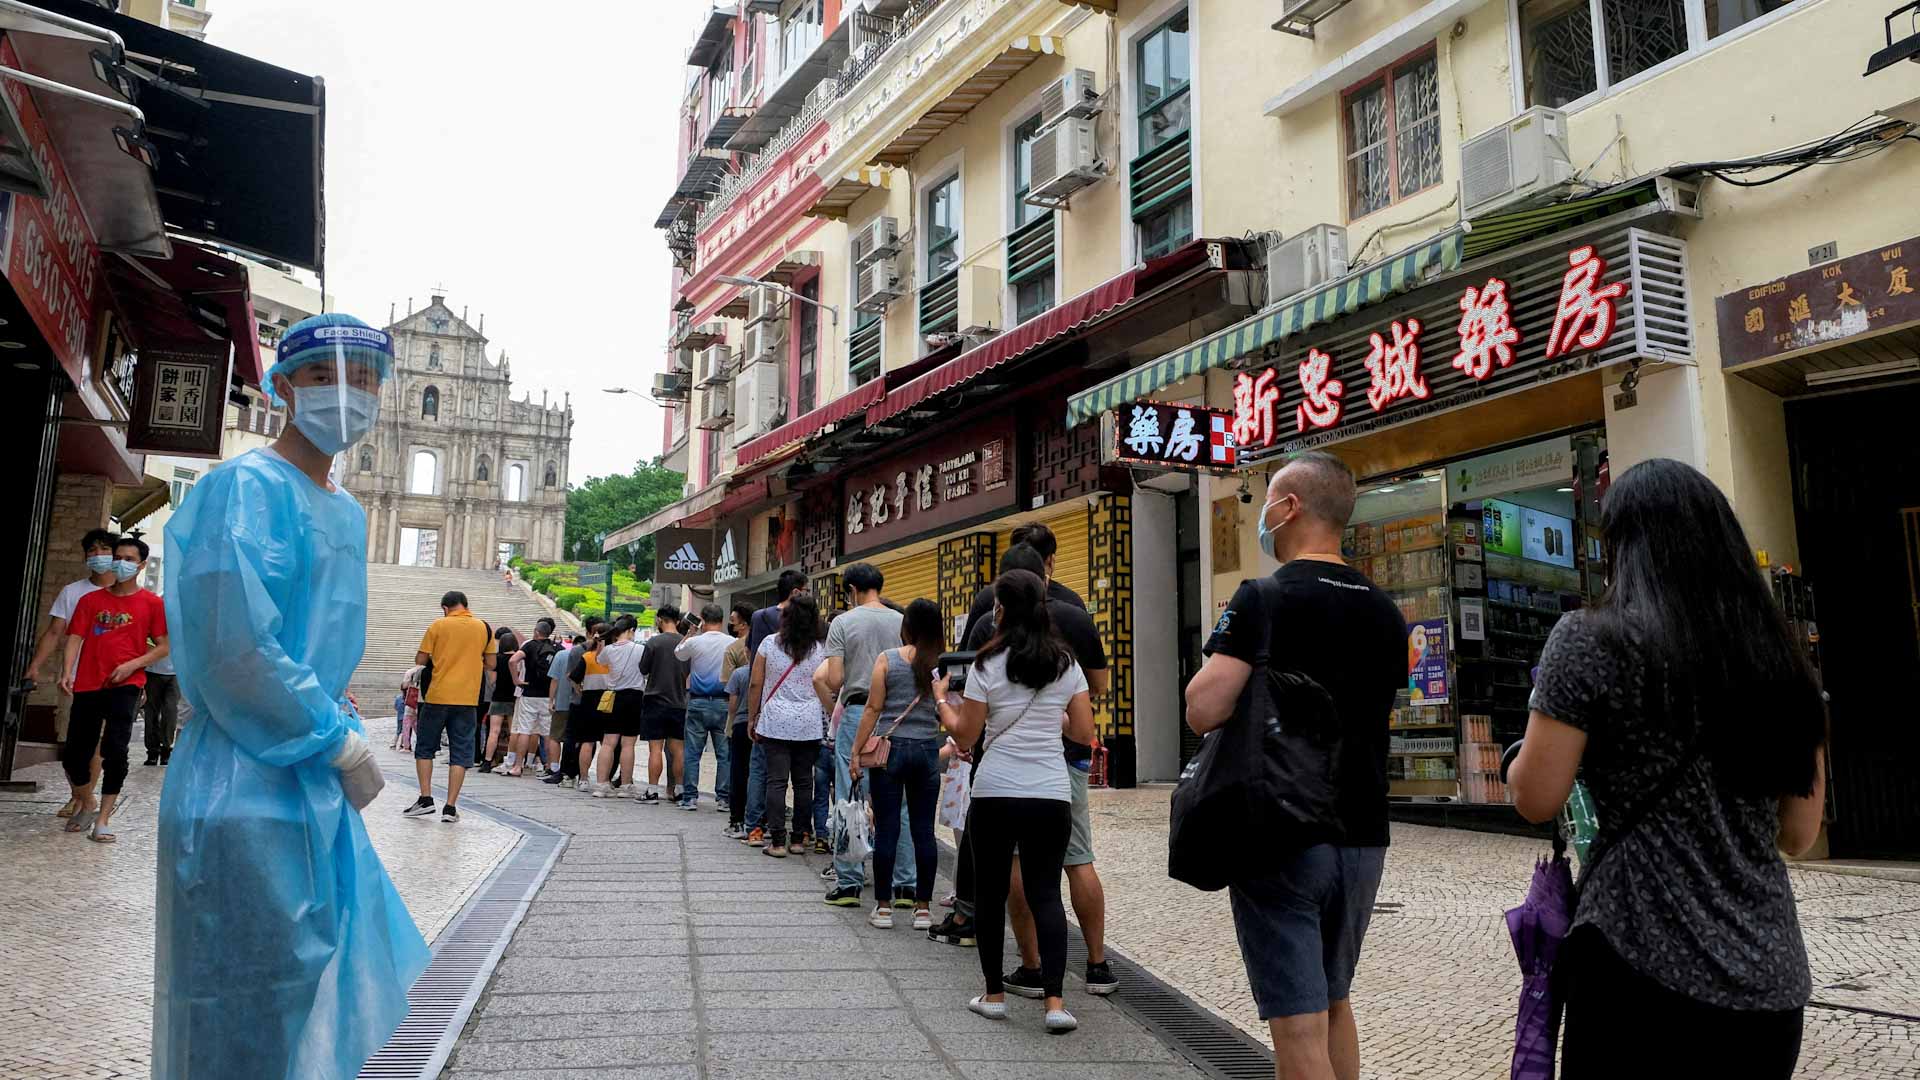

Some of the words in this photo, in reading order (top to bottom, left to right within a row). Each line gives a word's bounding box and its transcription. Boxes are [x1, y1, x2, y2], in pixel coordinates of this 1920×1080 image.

[1822, 246, 1833, 259] 21
[1749, 281, 1786, 300] EDIFICIO
[1822, 264, 1843, 279] KOK
[1881, 247, 1902, 262] WUI
[352, 329, 381, 341] Shield
[1232, 244, 1631, 448] 新忠誠藥房
[159, 368, 179, 403] 餅家
[180, 370, 202, 425] 咀香園
[1124, 405, 1205, 461] 藥房
[663, 561, 706, 571] adidas
[713, 562, 739, 584] adidas
